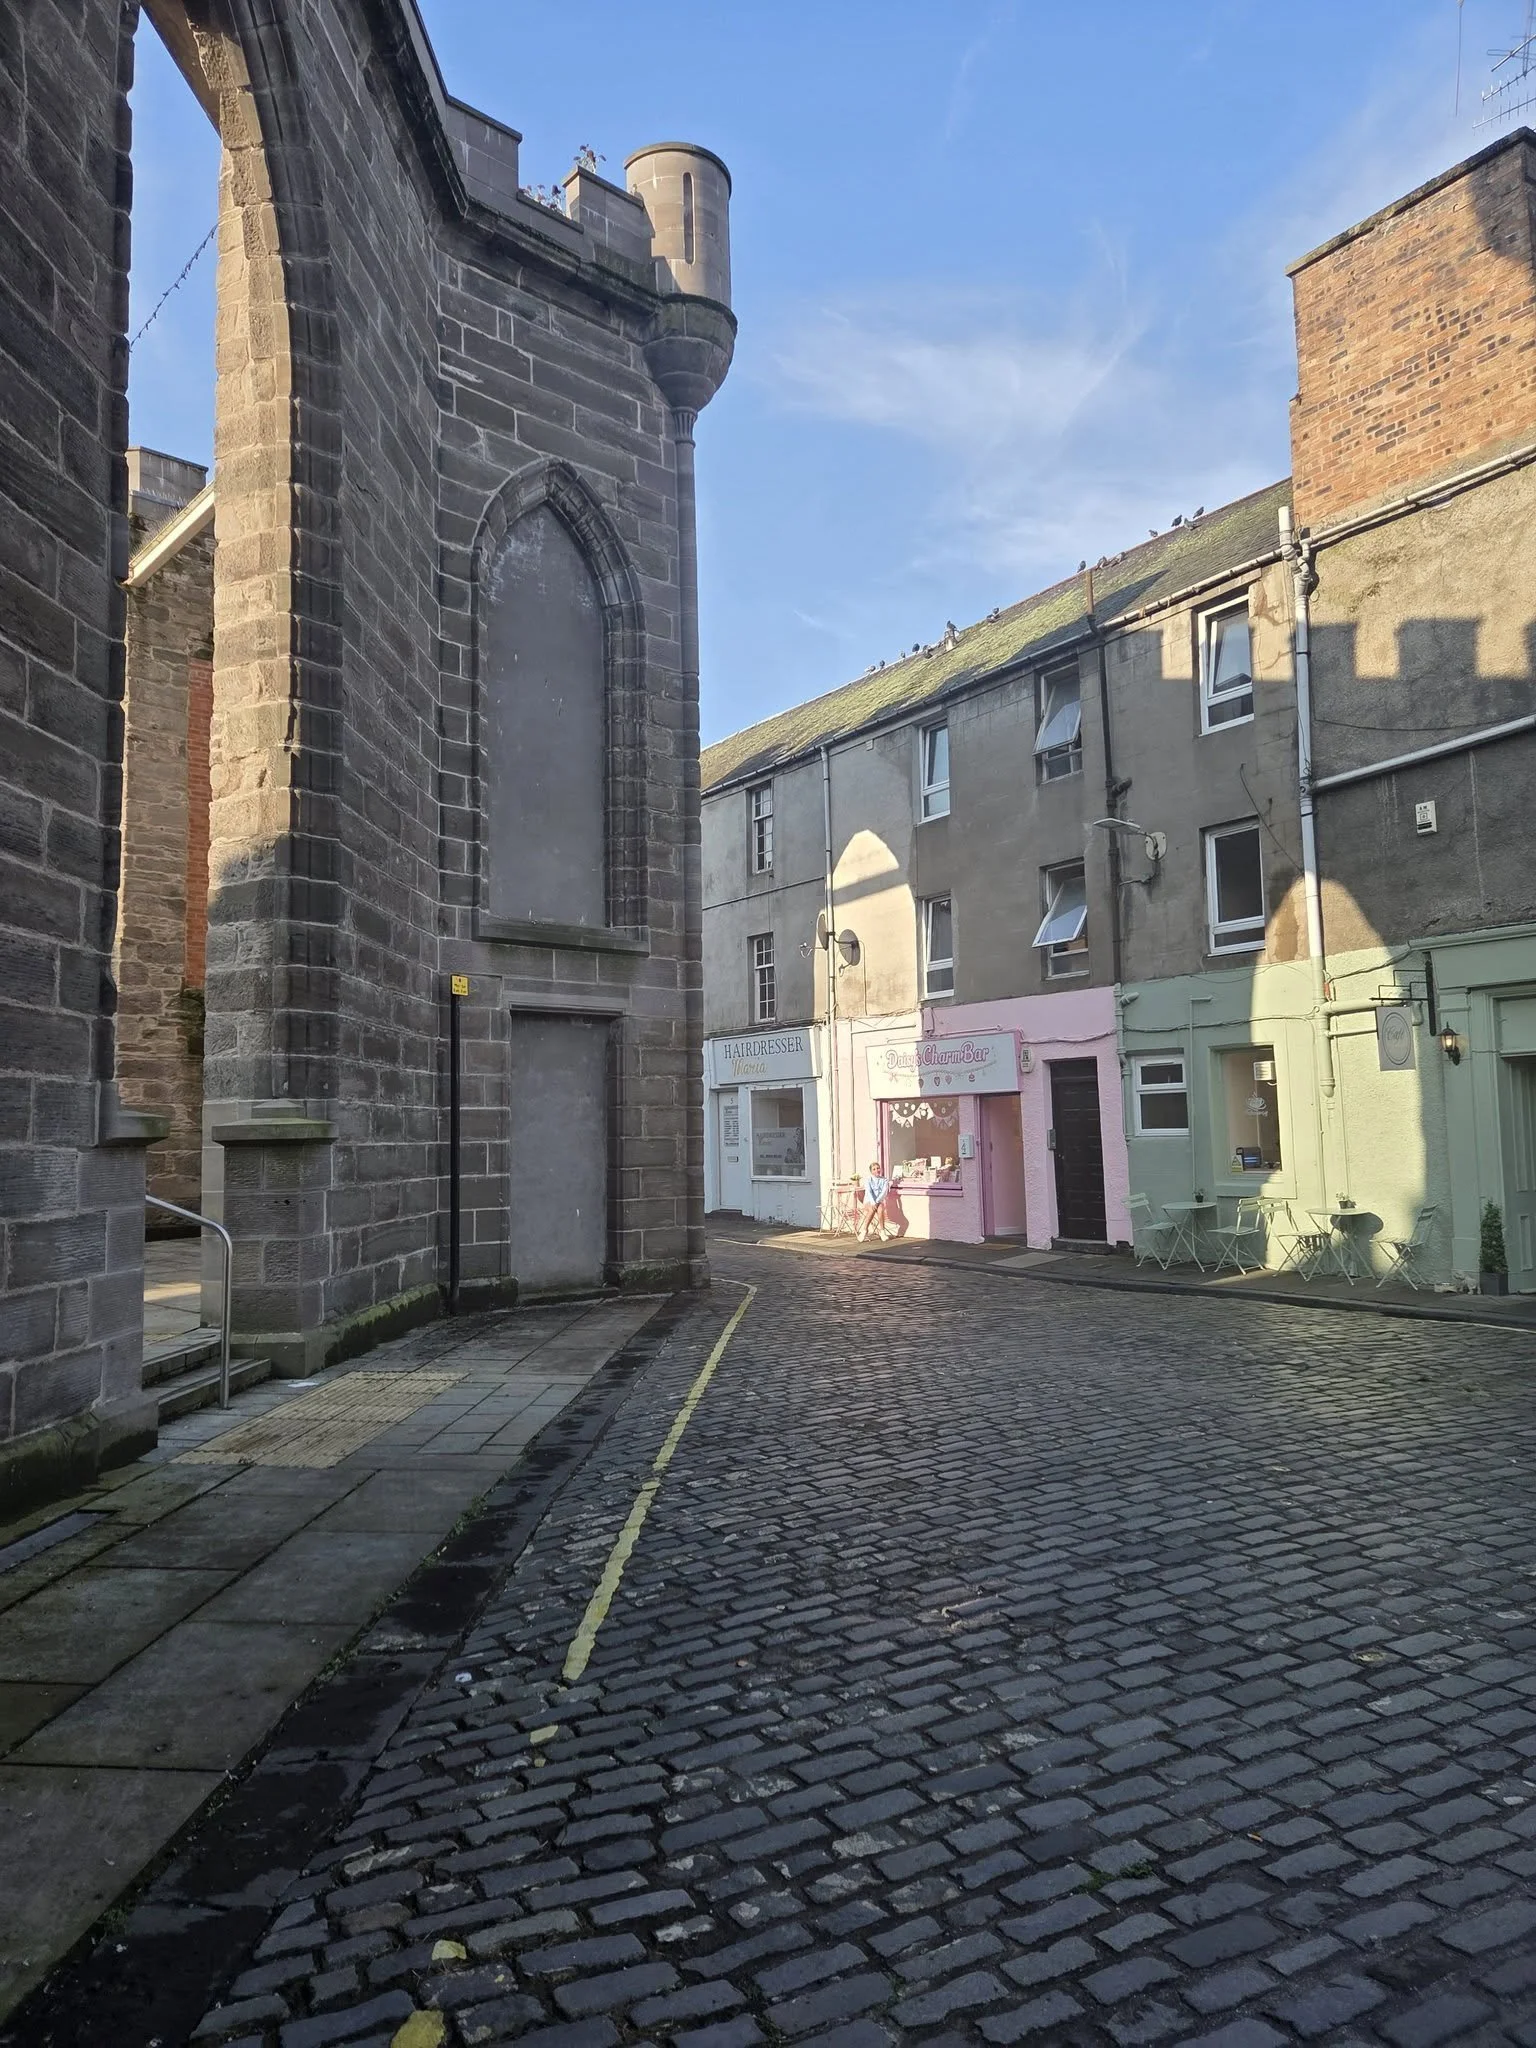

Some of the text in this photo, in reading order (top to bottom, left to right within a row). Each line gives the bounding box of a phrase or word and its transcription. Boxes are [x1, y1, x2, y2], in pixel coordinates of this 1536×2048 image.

[724, 1036, 804, 1059] HAIRDRESSER
[886, 1040, 990, 1072] Daisy's Charm Bar
[732, 1058, 768, 1078] Maria
